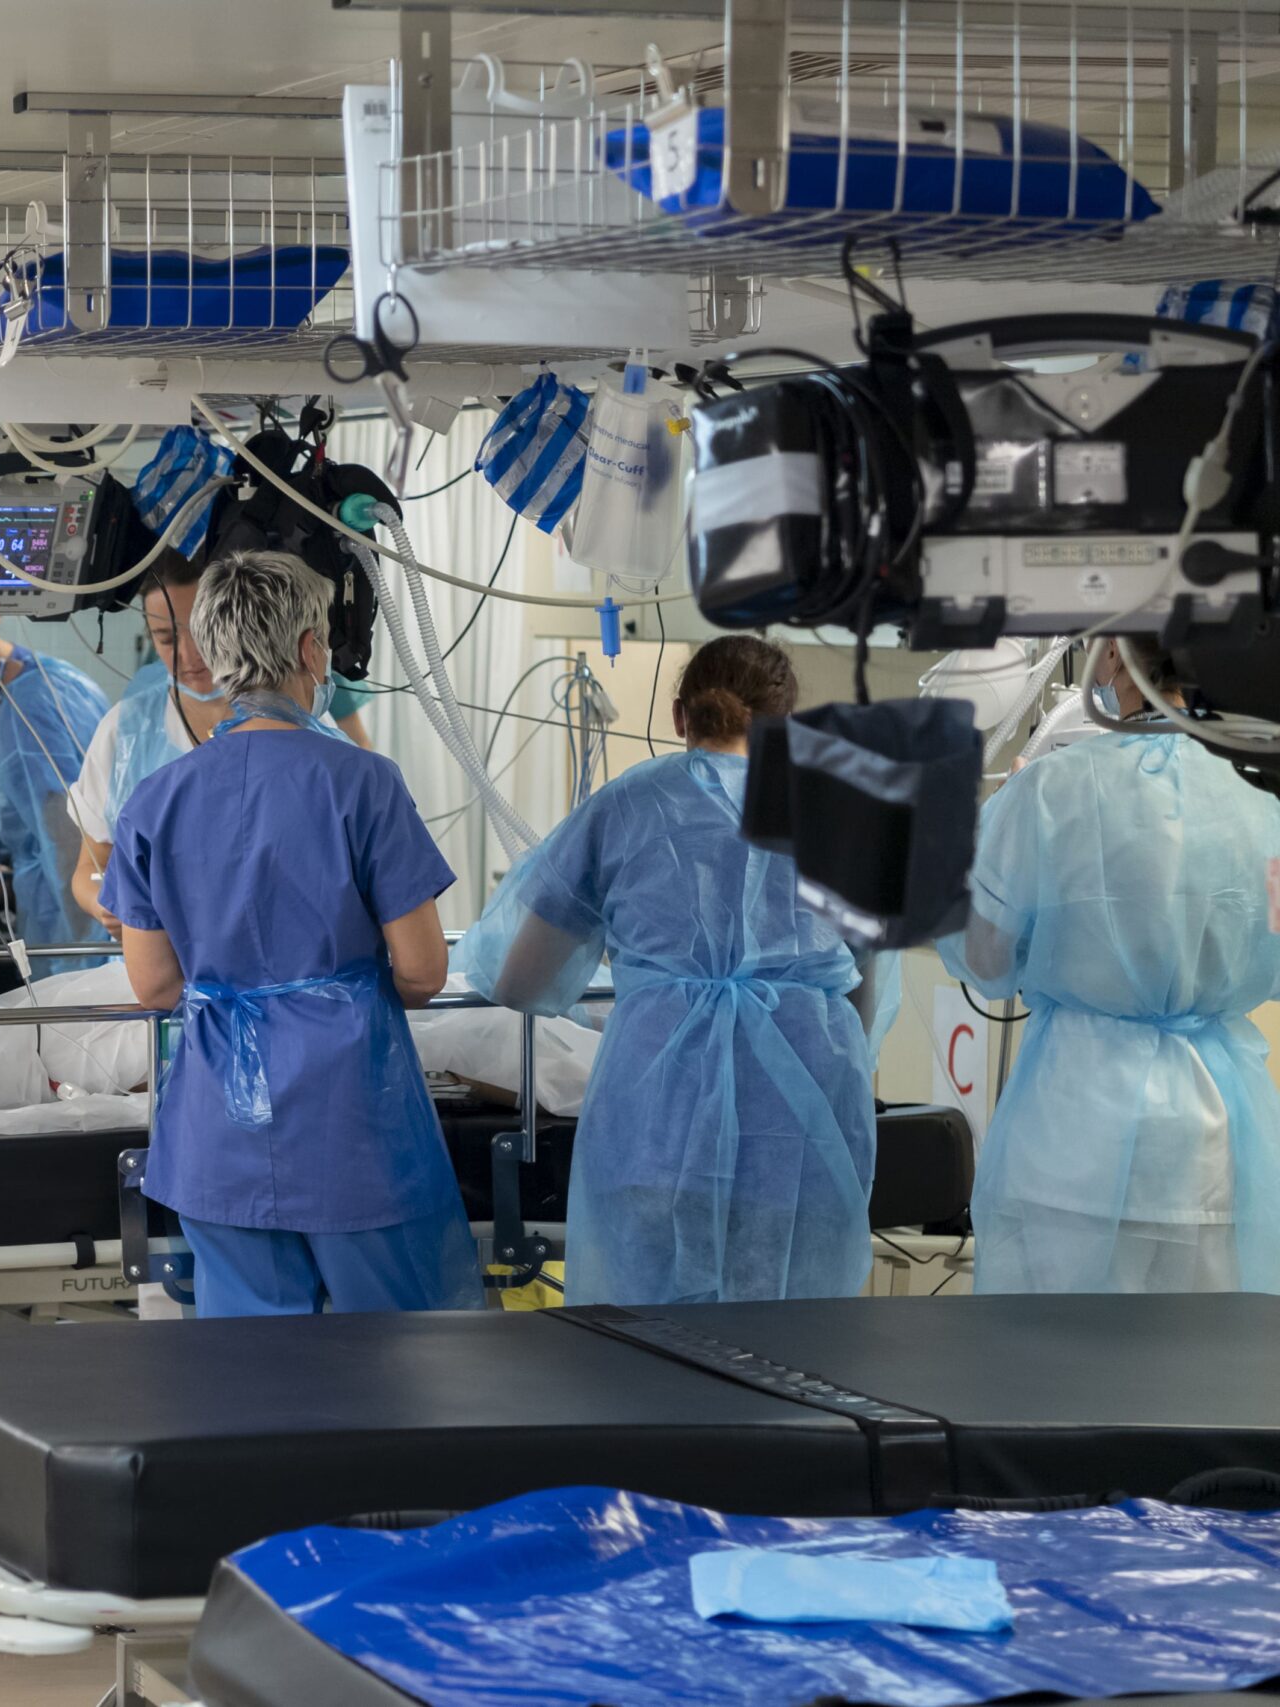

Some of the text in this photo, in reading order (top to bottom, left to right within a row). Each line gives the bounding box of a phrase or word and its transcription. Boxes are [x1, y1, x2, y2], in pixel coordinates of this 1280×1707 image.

[667, 129, 679, 173] 5
[588, 445, 645, 476] Clear-Cuff
[11, 538, 24, 551] 64
[948, 1023, 975, 1095] C
